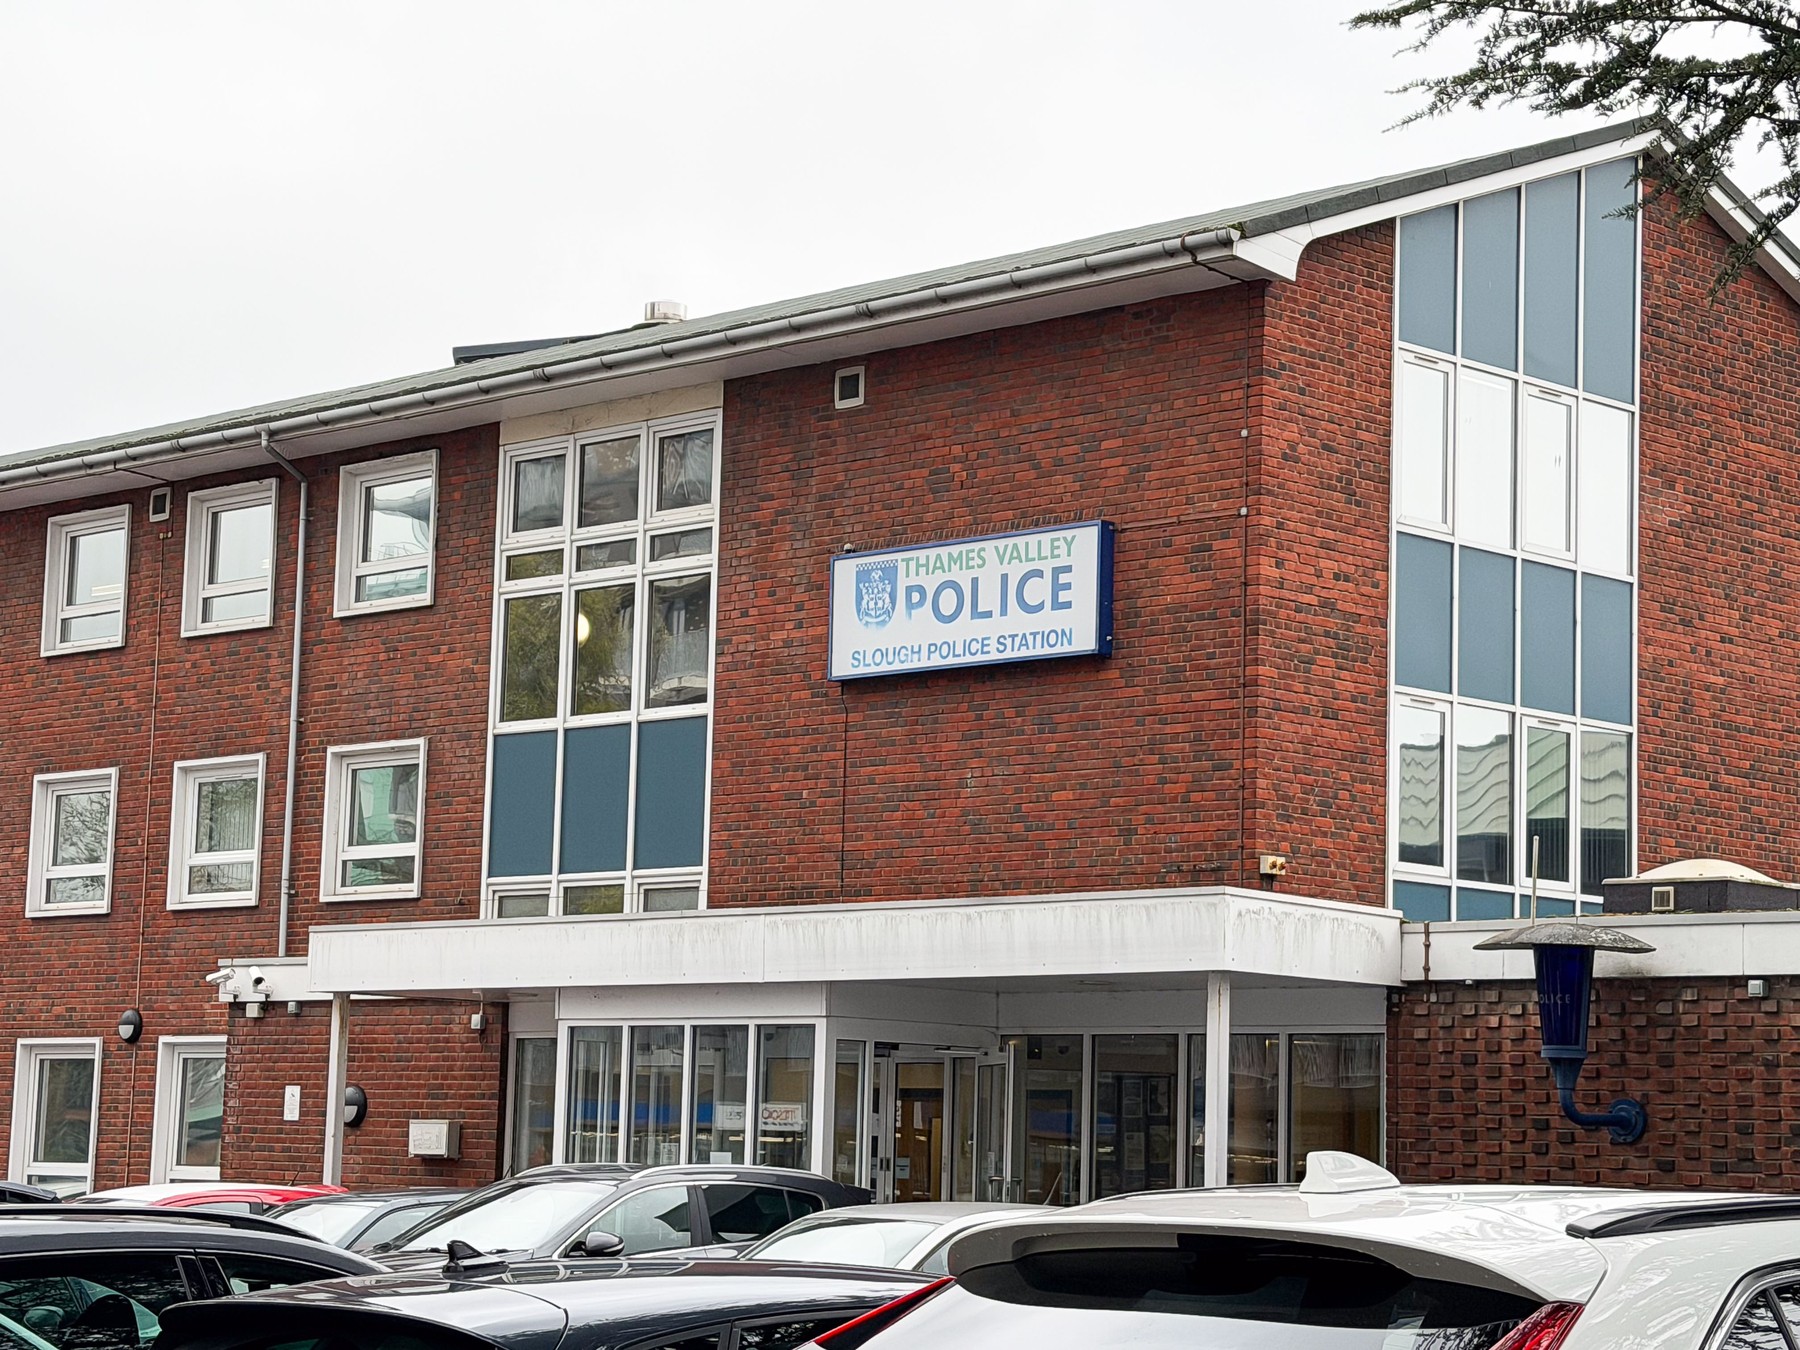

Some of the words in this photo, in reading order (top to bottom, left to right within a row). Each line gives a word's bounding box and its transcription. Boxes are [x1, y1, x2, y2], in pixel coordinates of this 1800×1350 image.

[901, 547, 986, 578] THAMES
[994, 535, 1077, 566] VALLEY
[905, 565, 1073, 624] POLICE
[851, 643, 921, 668] SLOUGH
[927, 636, 991, 661] POLICE
[996, 627, 1073, 653] STATION
[1538, 993, 1571, 1004] OLICE
